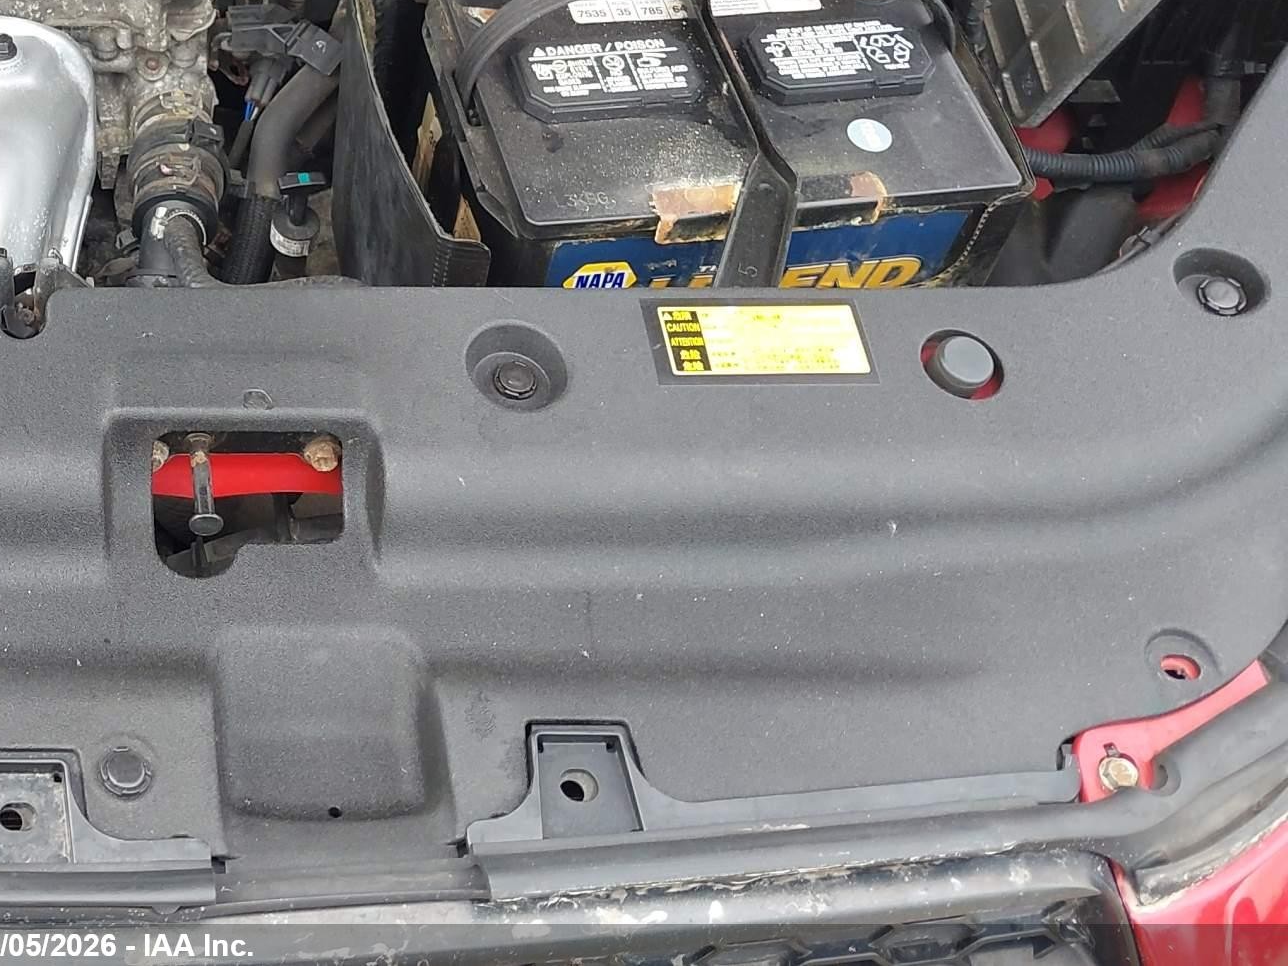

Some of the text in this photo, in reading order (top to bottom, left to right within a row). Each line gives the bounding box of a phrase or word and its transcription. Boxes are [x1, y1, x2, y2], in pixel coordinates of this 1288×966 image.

[576, 8, 607, 19] 7535
[616, 8, 632, 17] 35
[640, 6, 664, 16] 785
[545, 38, 666, 57] DANGER / POISON
[575, 271, 625, 288] NAPA
[666, 322, 700, 332] CAUTION
[670, 336, 705, 347] ATTENTION
